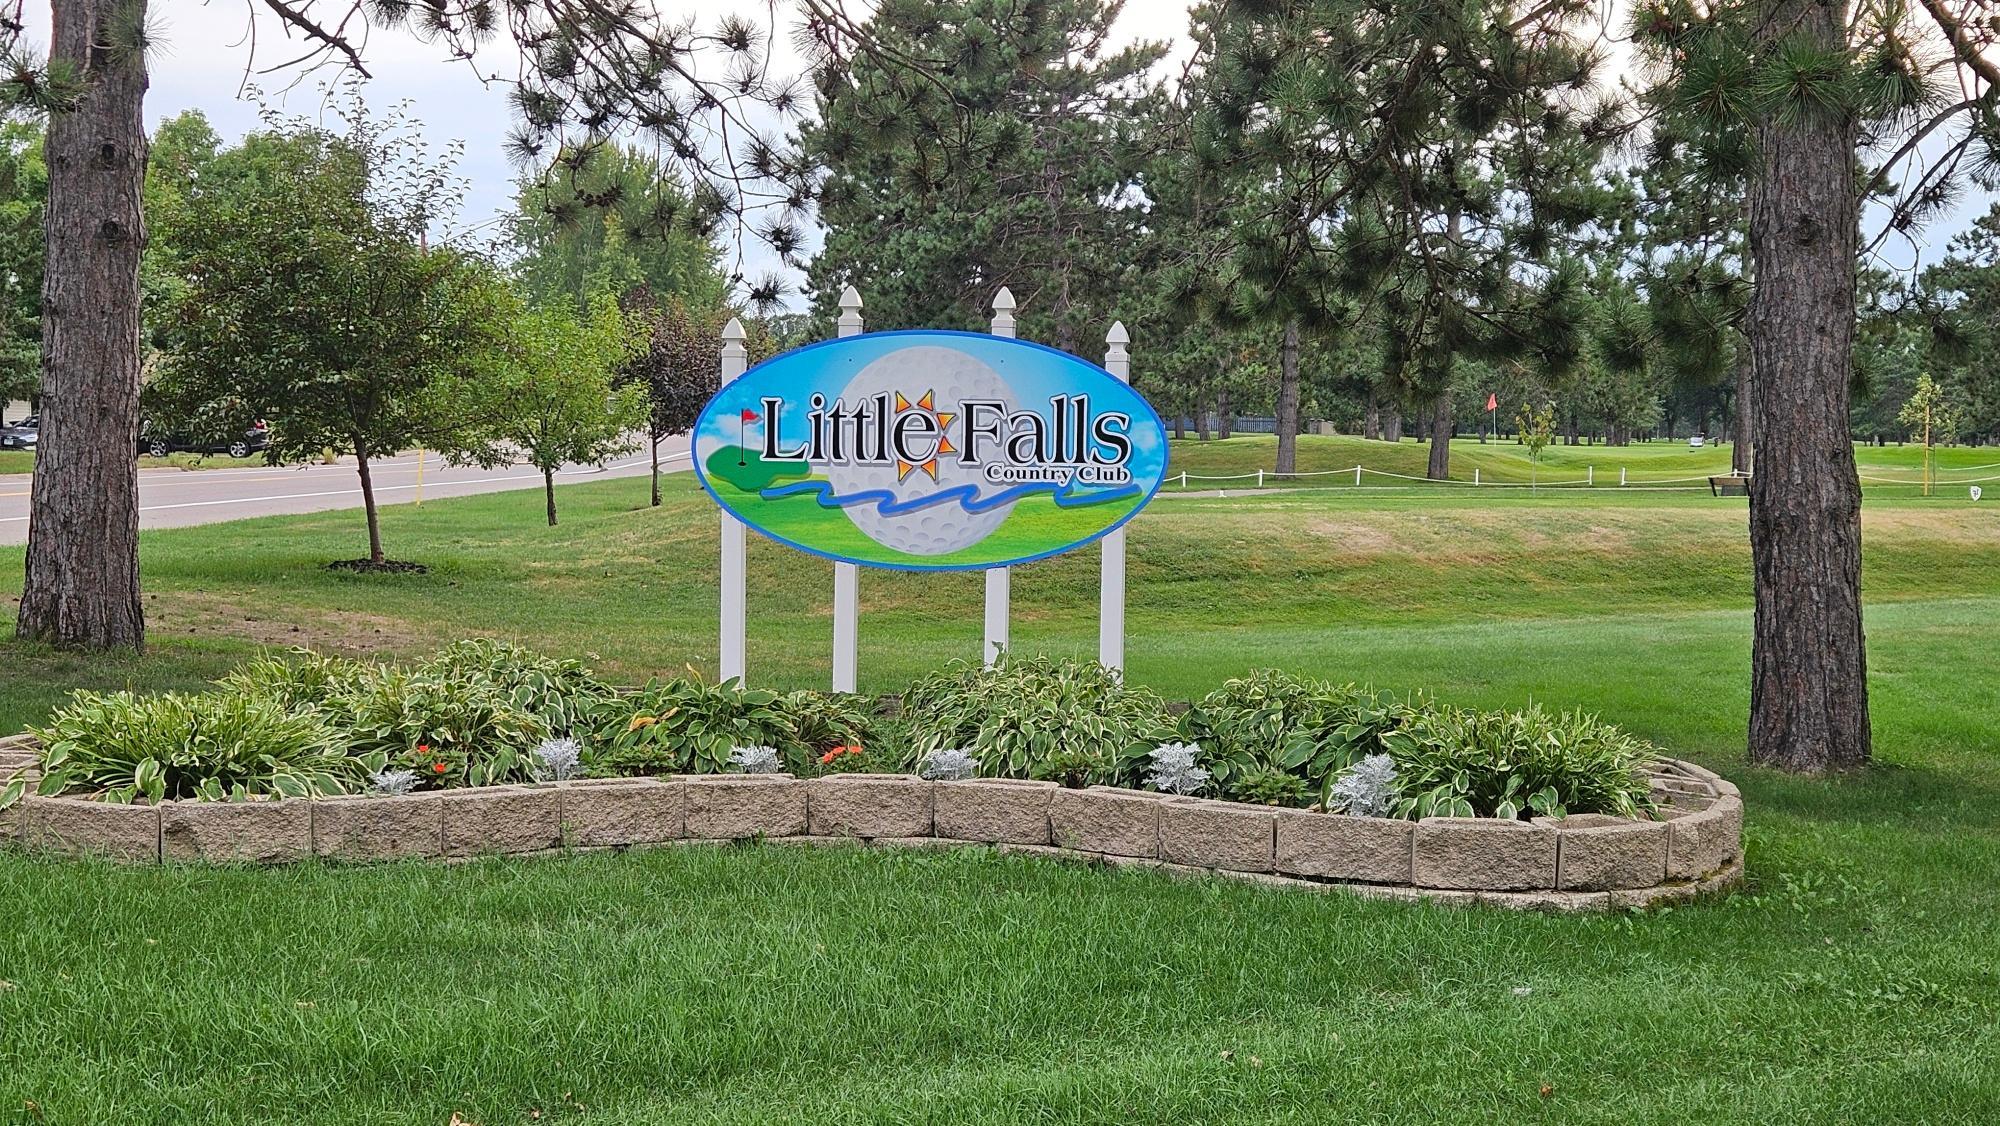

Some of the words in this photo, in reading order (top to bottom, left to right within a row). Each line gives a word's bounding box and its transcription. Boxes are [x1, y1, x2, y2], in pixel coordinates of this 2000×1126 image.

[760, 392, 939, 464] Little
[959, 393, 1132, 466] Falls
[985, 463, 1073, 485] Country
[1078, 465, 1130, 482] Club
